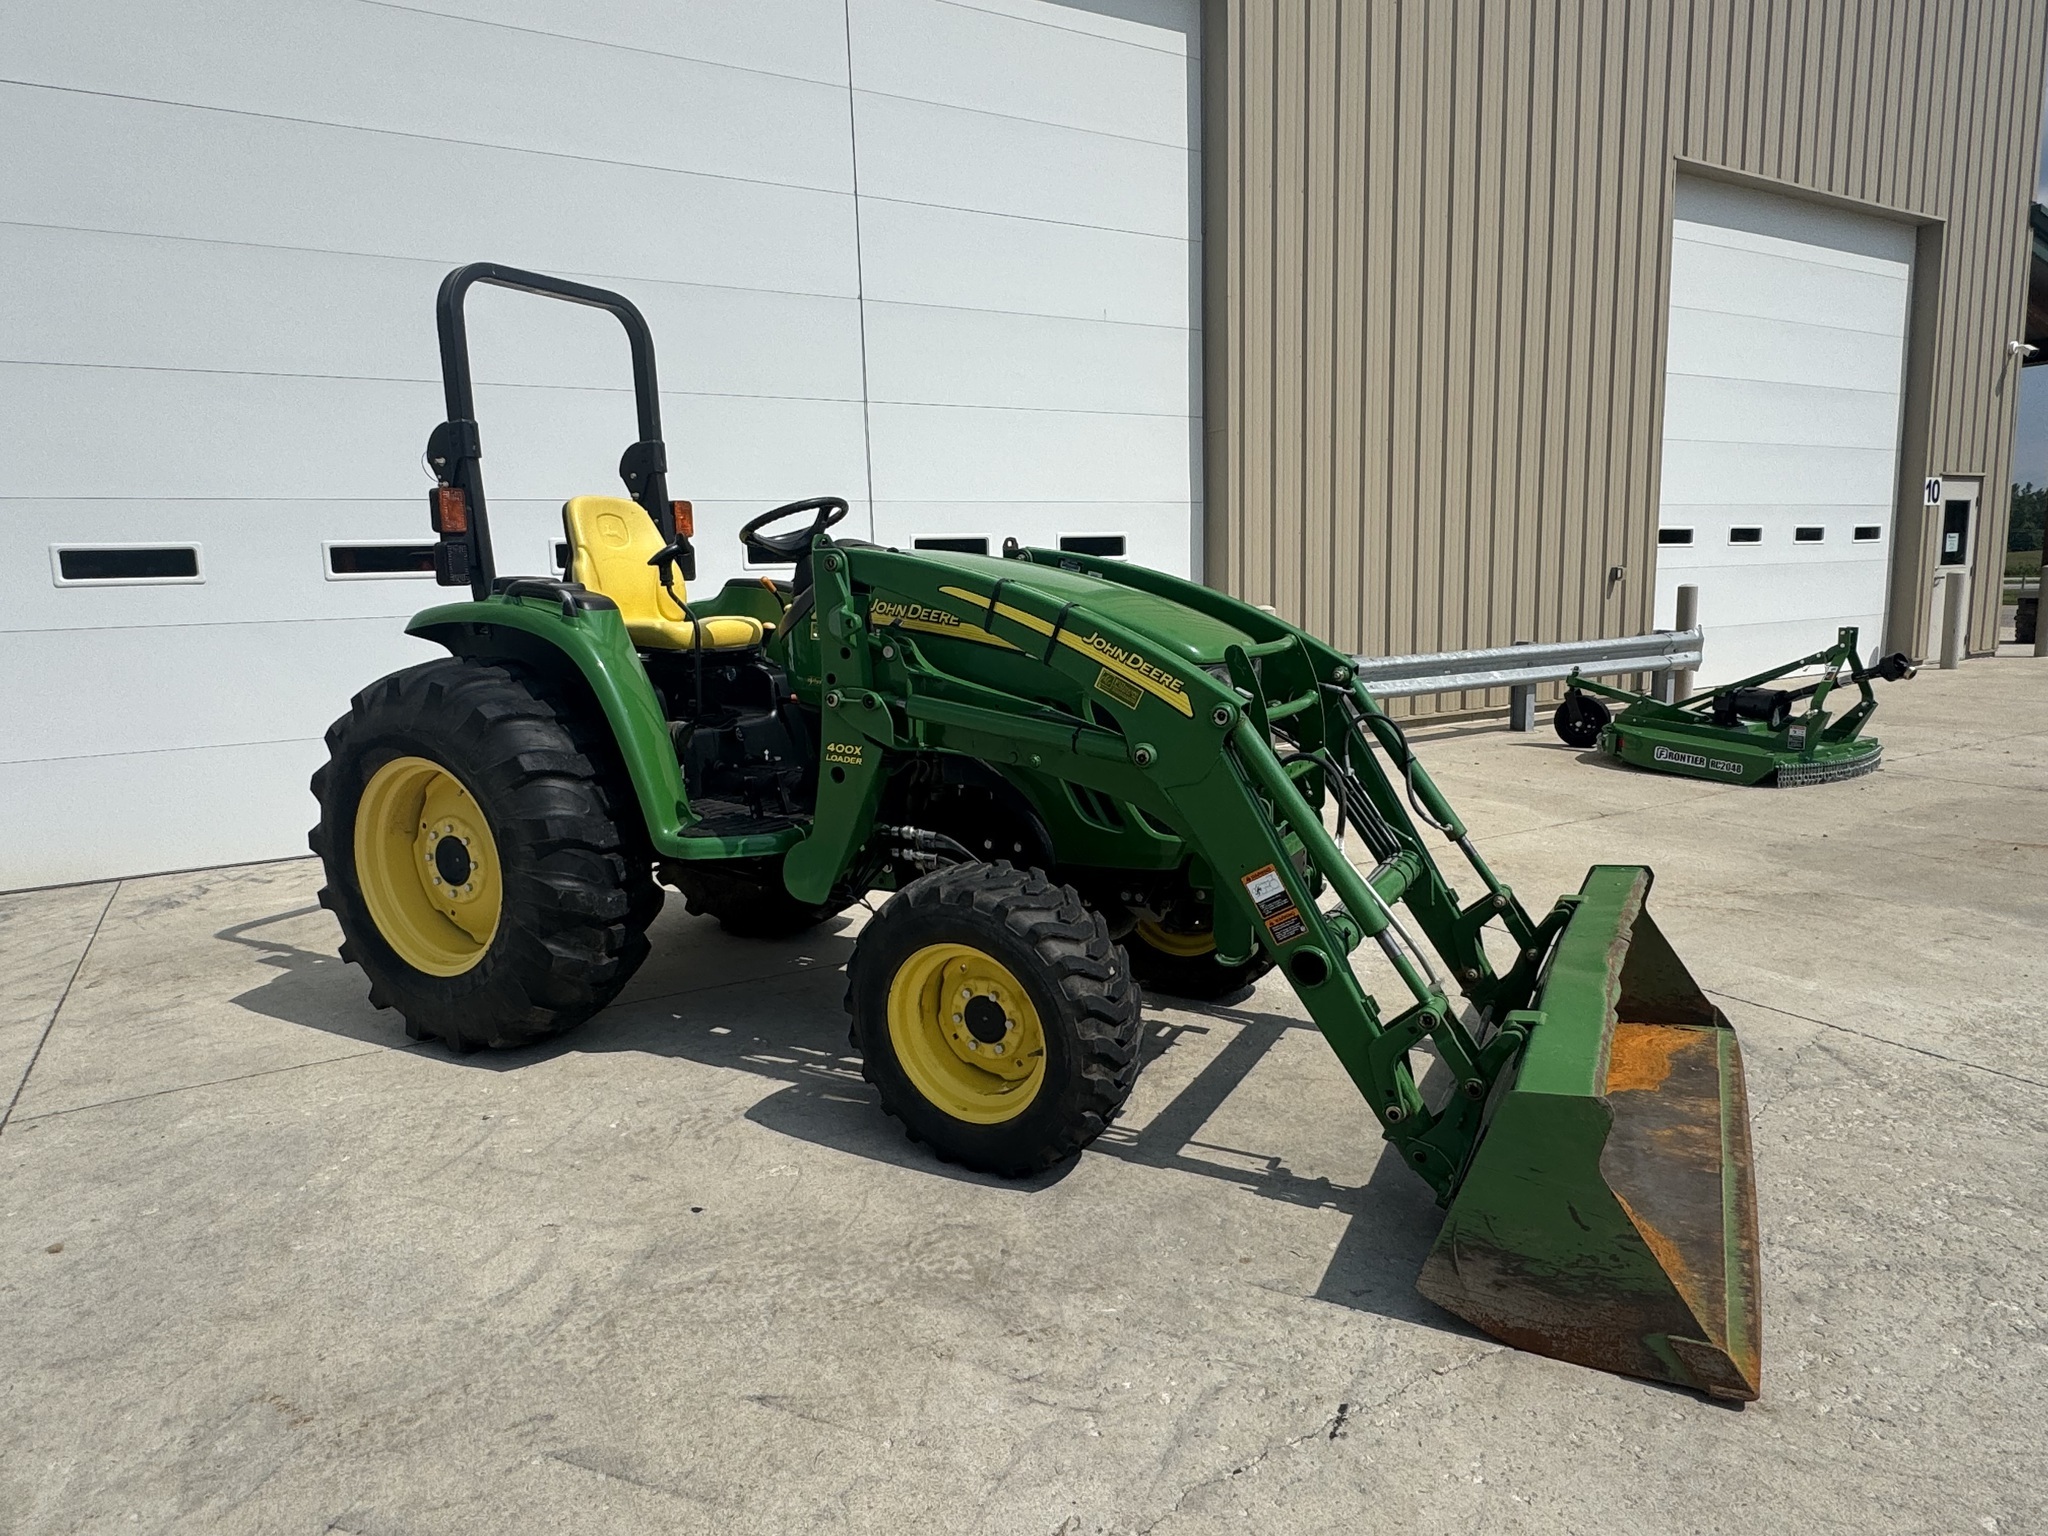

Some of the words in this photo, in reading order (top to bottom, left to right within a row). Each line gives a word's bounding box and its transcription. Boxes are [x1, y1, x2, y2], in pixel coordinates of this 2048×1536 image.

[1925, 479, 1941, 504] 10
[870, 599, 908, 617] JOHN
[907, 603, 960, 625] DEERE
[1082, 631, 1129, 662] JOHN
[1126, 652, 1185, 692] DEERE
[825, 753, 863, 766] LOADER
[826, 742, 863, 756] 400X
[1655, 747, 1705, 767] FRONTIER
[1710, 760, 1743, 774] RC2048
